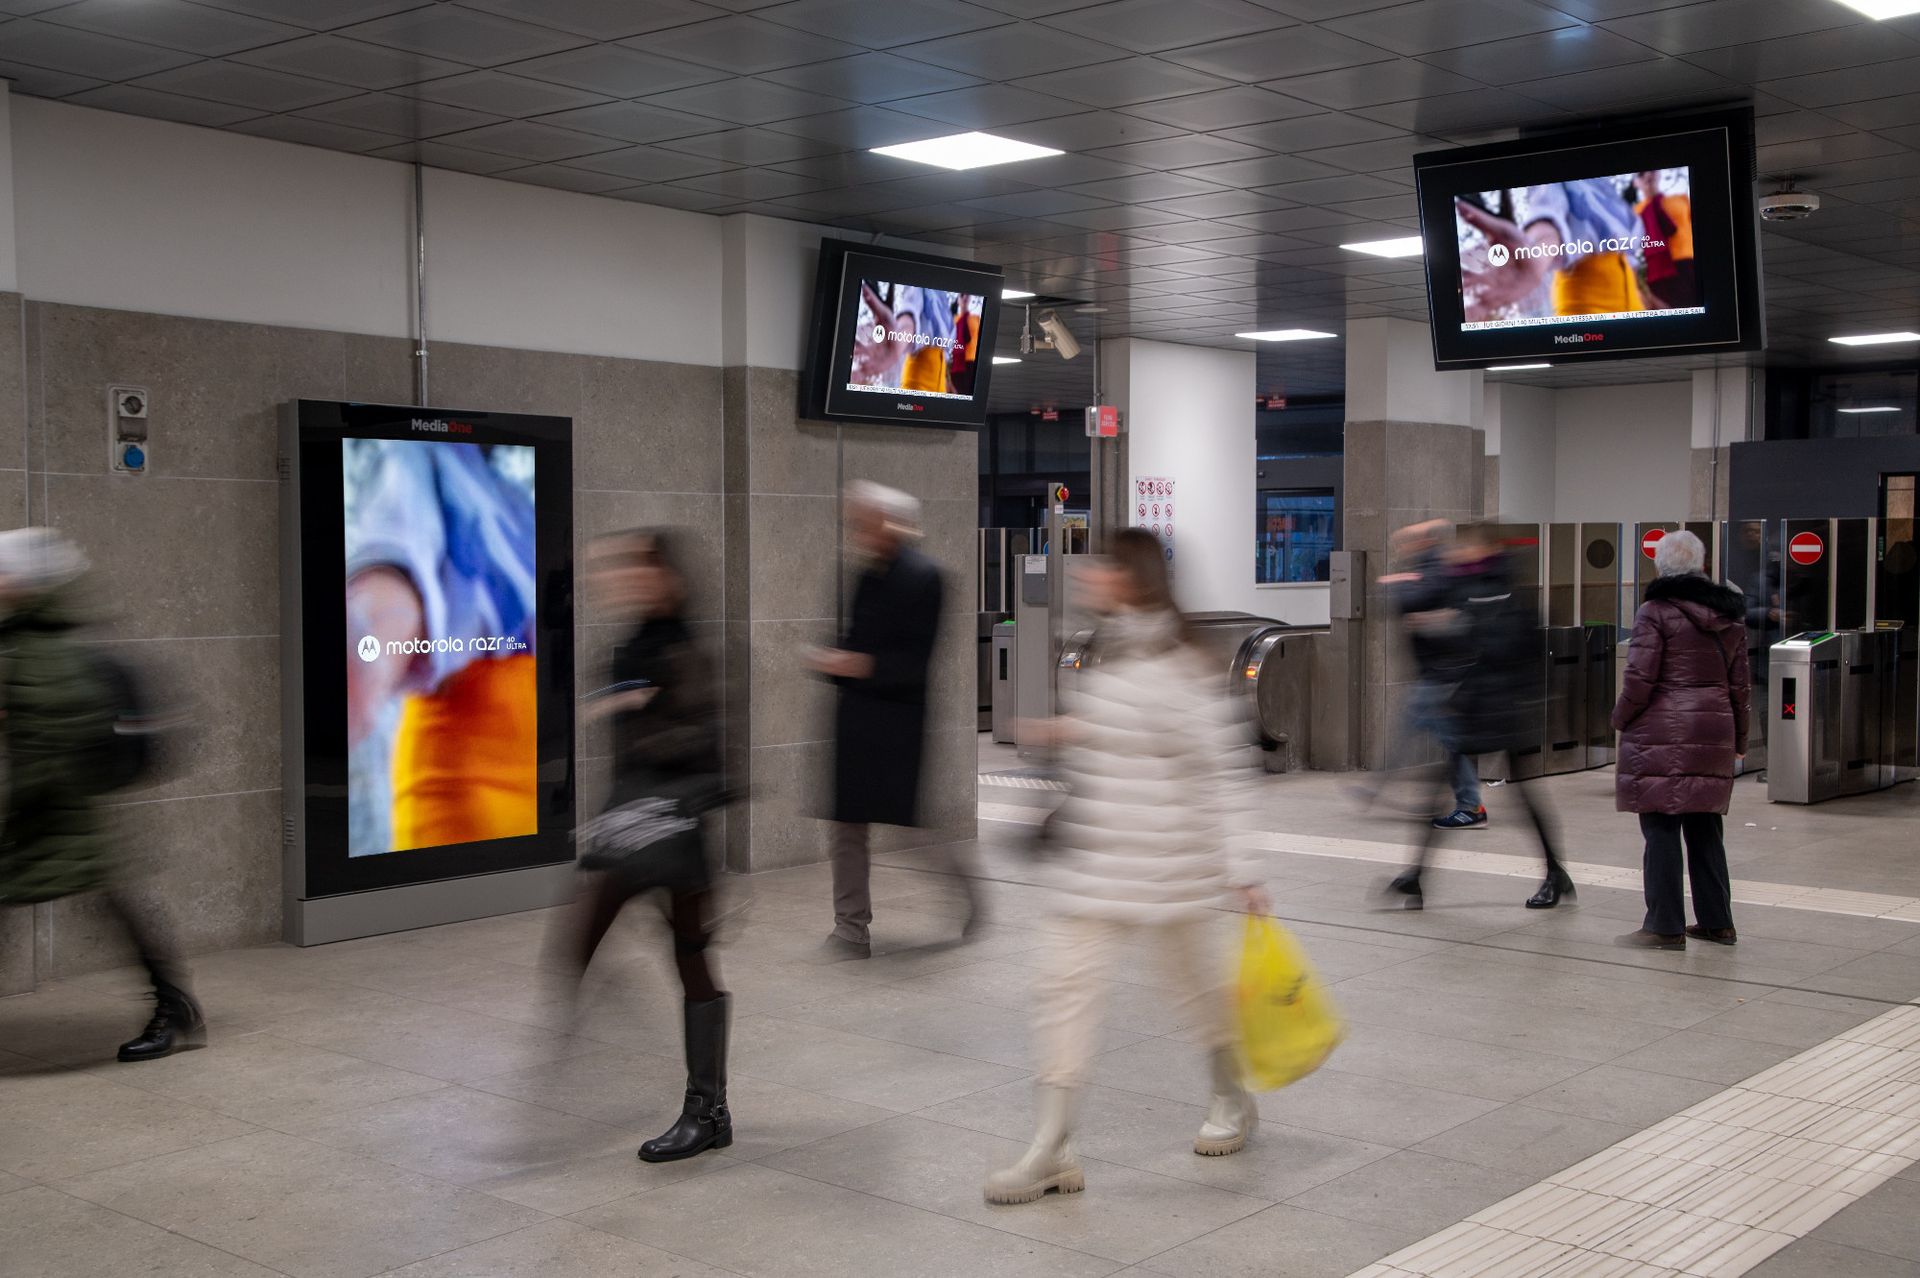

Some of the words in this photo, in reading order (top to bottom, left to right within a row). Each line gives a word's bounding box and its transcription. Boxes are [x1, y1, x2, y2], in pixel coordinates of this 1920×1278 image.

[1514, 239, 1593, 260] motorola
[1600, 236, 1637, 252] razr
[1640, 241, 1665, 249] ULTRA
[887, 330, 930, 346] motorola
[932, 336, 953, 348] razr
[1554, 332, 1604, 344] MediaOne
[411, 418, 473, 433] MediaOne
[386, 636, 463, 655] motorola
[469, 636, 504, 651] razr
